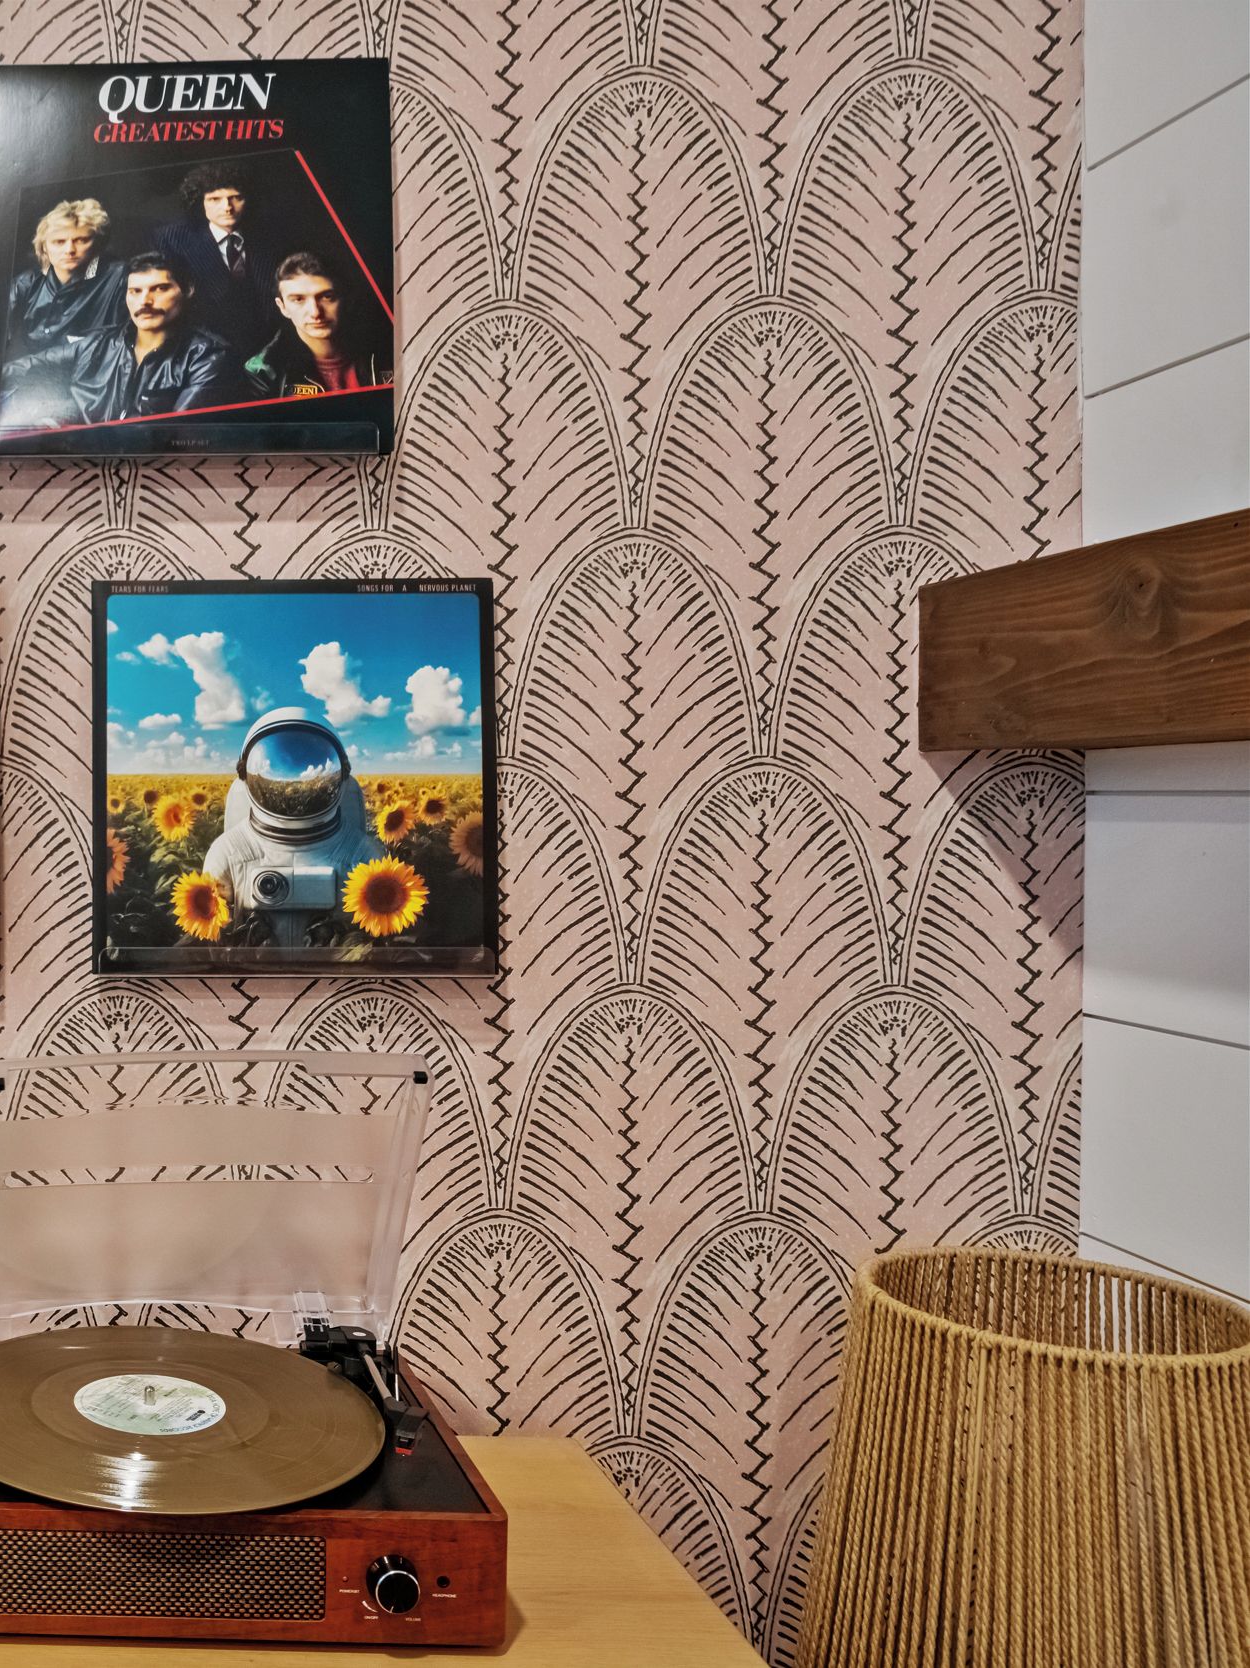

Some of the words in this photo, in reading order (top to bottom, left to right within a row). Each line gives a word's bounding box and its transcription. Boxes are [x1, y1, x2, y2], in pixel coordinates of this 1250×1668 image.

[98, 73, 277, 124] QUEEN
[93, 121, 223, 144] GREATEST
[225, 119, 285, 140] HITS
[357, 584, 379, 592] SONGS
[381, 584, 394, 592] FOR
[402, 584, 407, 592] A
[419, 583, 449, 592] NERVOUS
[451, 583, 477, 592] PLANET
